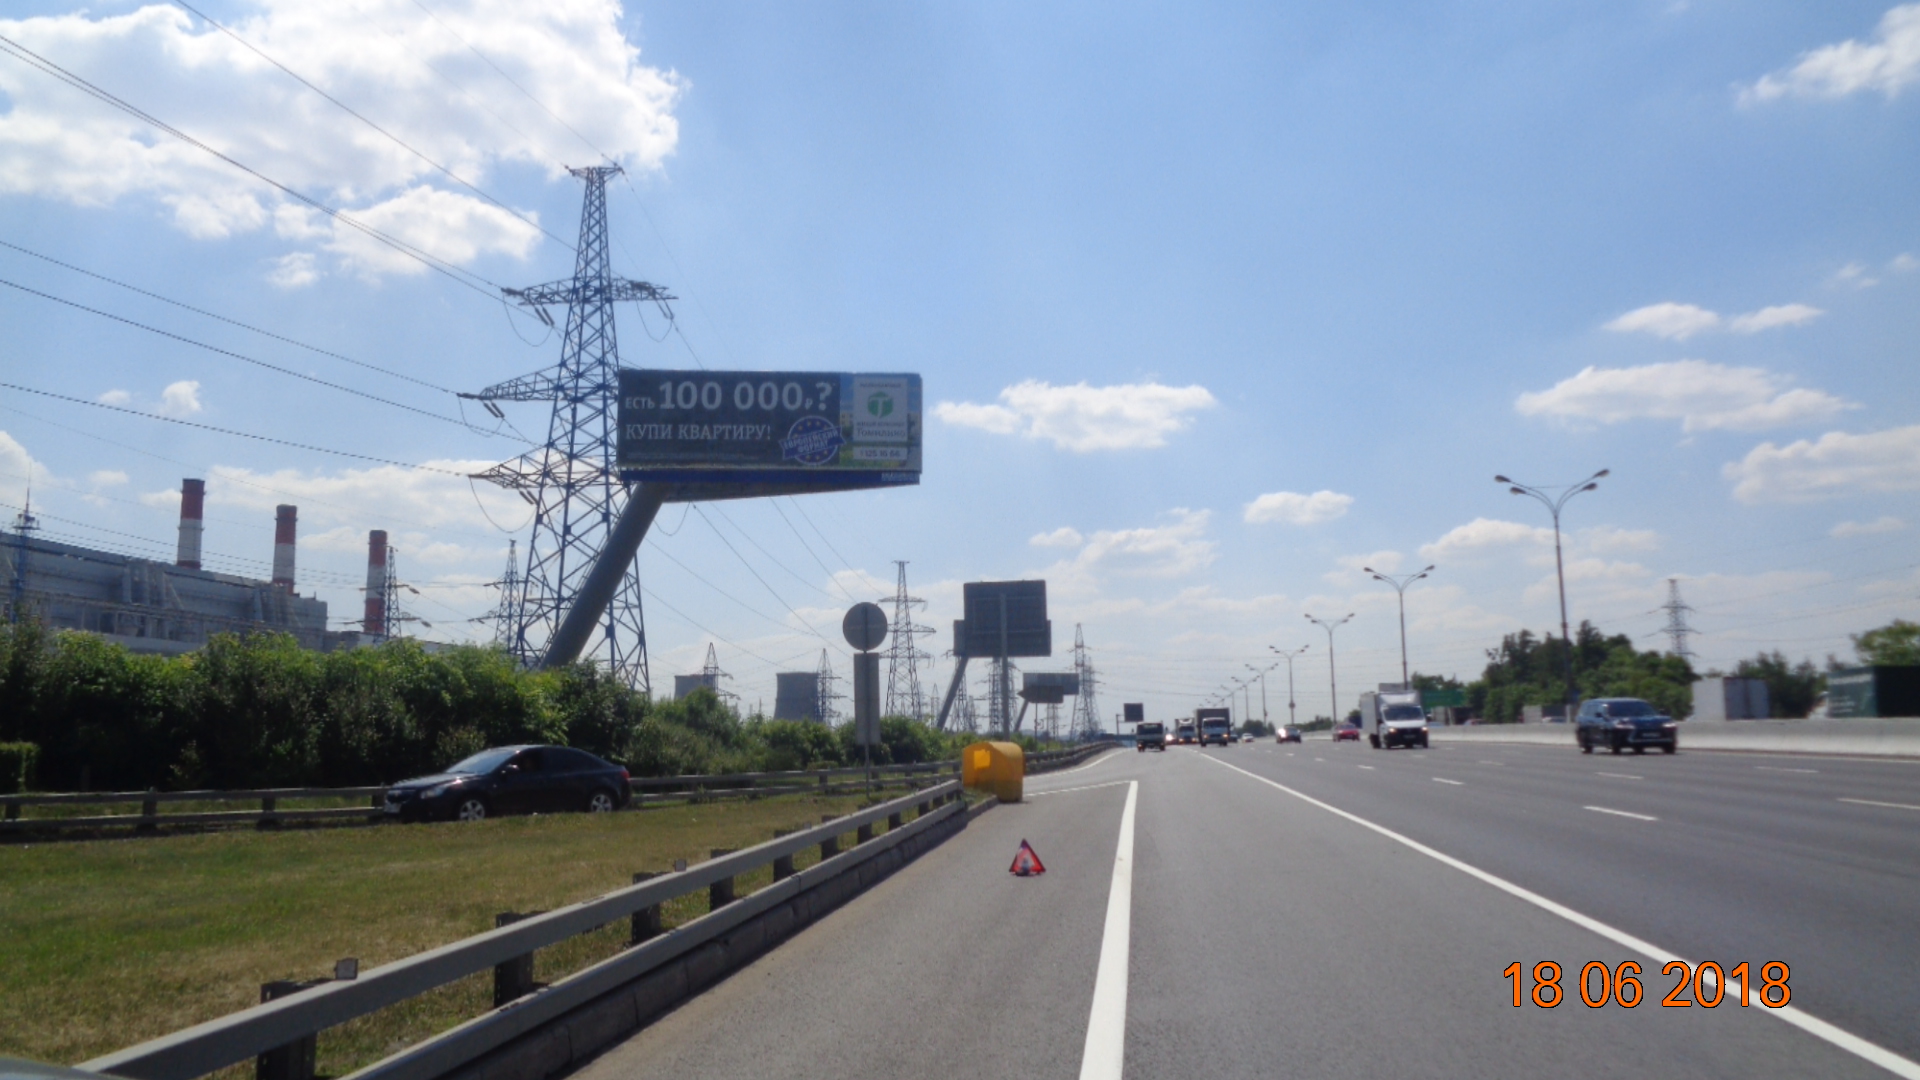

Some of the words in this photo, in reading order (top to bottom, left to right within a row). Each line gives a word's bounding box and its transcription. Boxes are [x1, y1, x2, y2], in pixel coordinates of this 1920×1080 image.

[625, 397, 655, 410] ЕСТЬ
[659, 380, 722, 410] 100
[625, 424, 672, 440] КУПИ
[678, 424, 771, 441] КВАРТИРУ!
